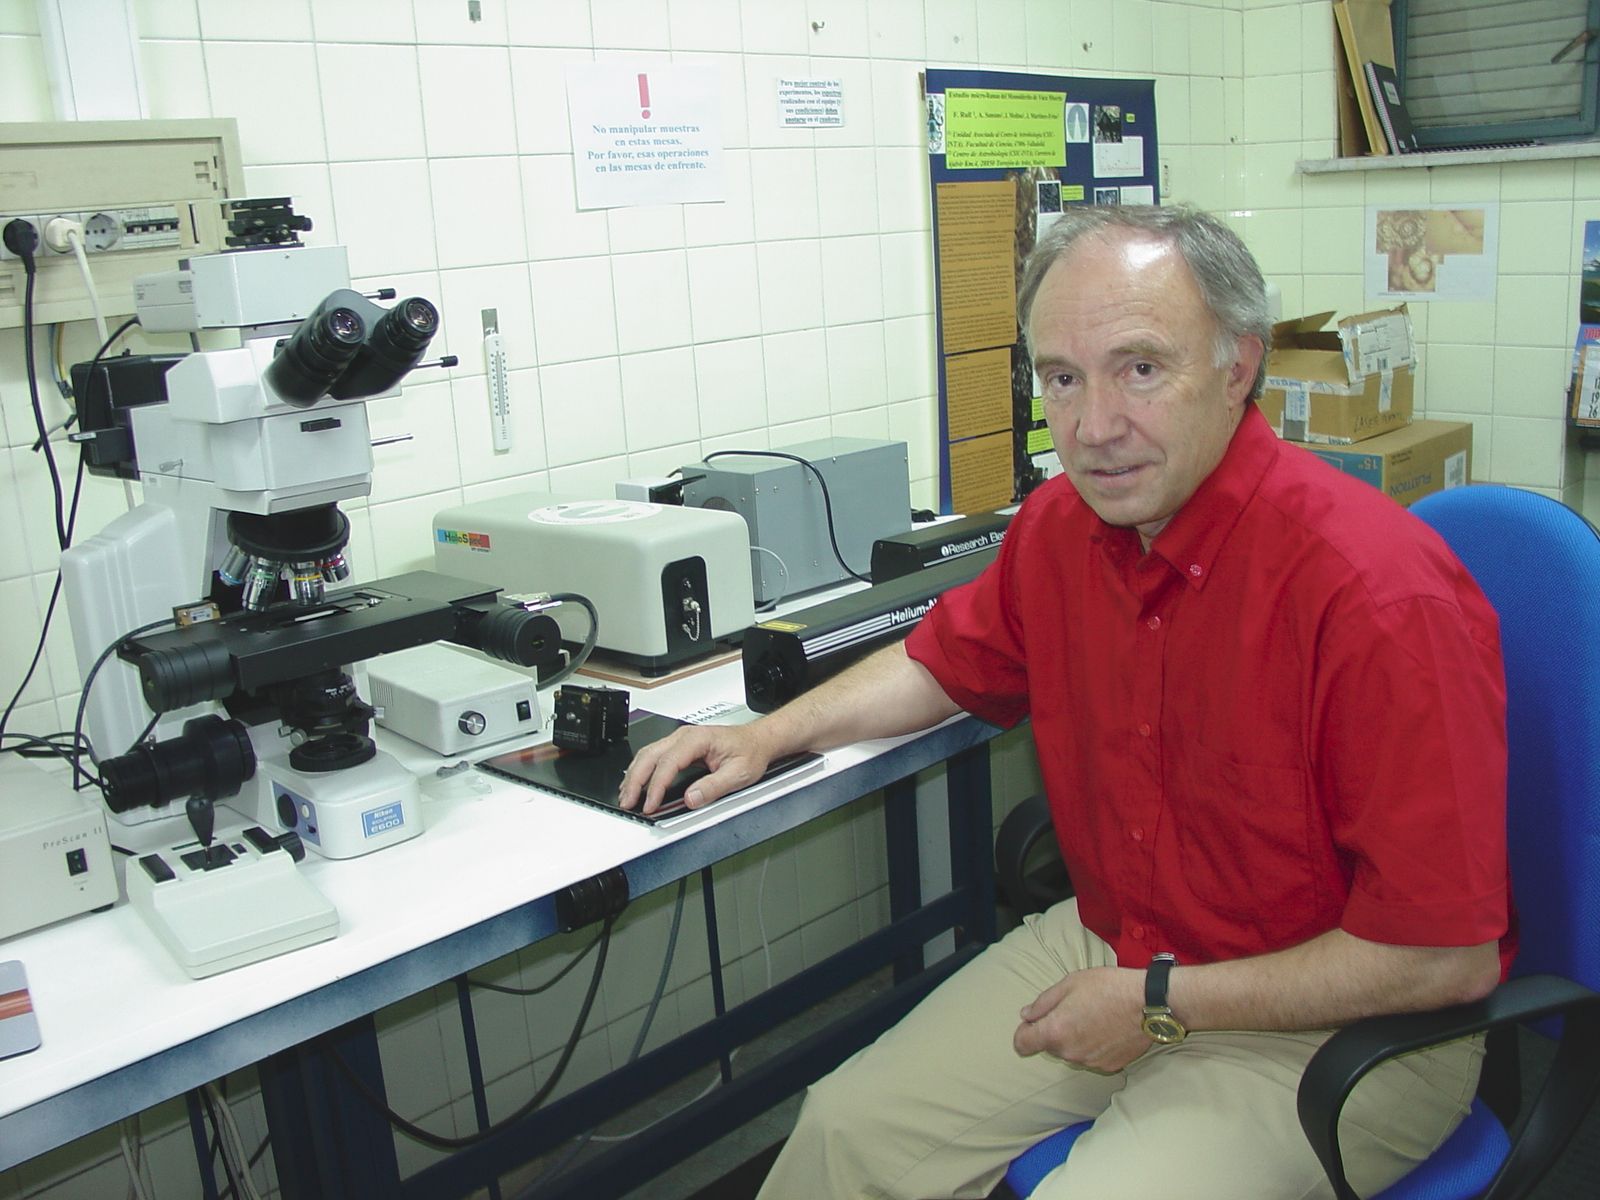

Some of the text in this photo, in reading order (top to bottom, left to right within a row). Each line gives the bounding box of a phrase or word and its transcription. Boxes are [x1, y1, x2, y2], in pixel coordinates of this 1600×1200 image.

[592, 124, 700, 135] No manipular muestras
[615, 137, 682, 146] en estas mesas.
[588, 149, 709, 160] Por favor, esas operaciones
[595, 161, 706, 173] en las mesas de enfrente.
[948, 530, 1008, 555] Research Elec
